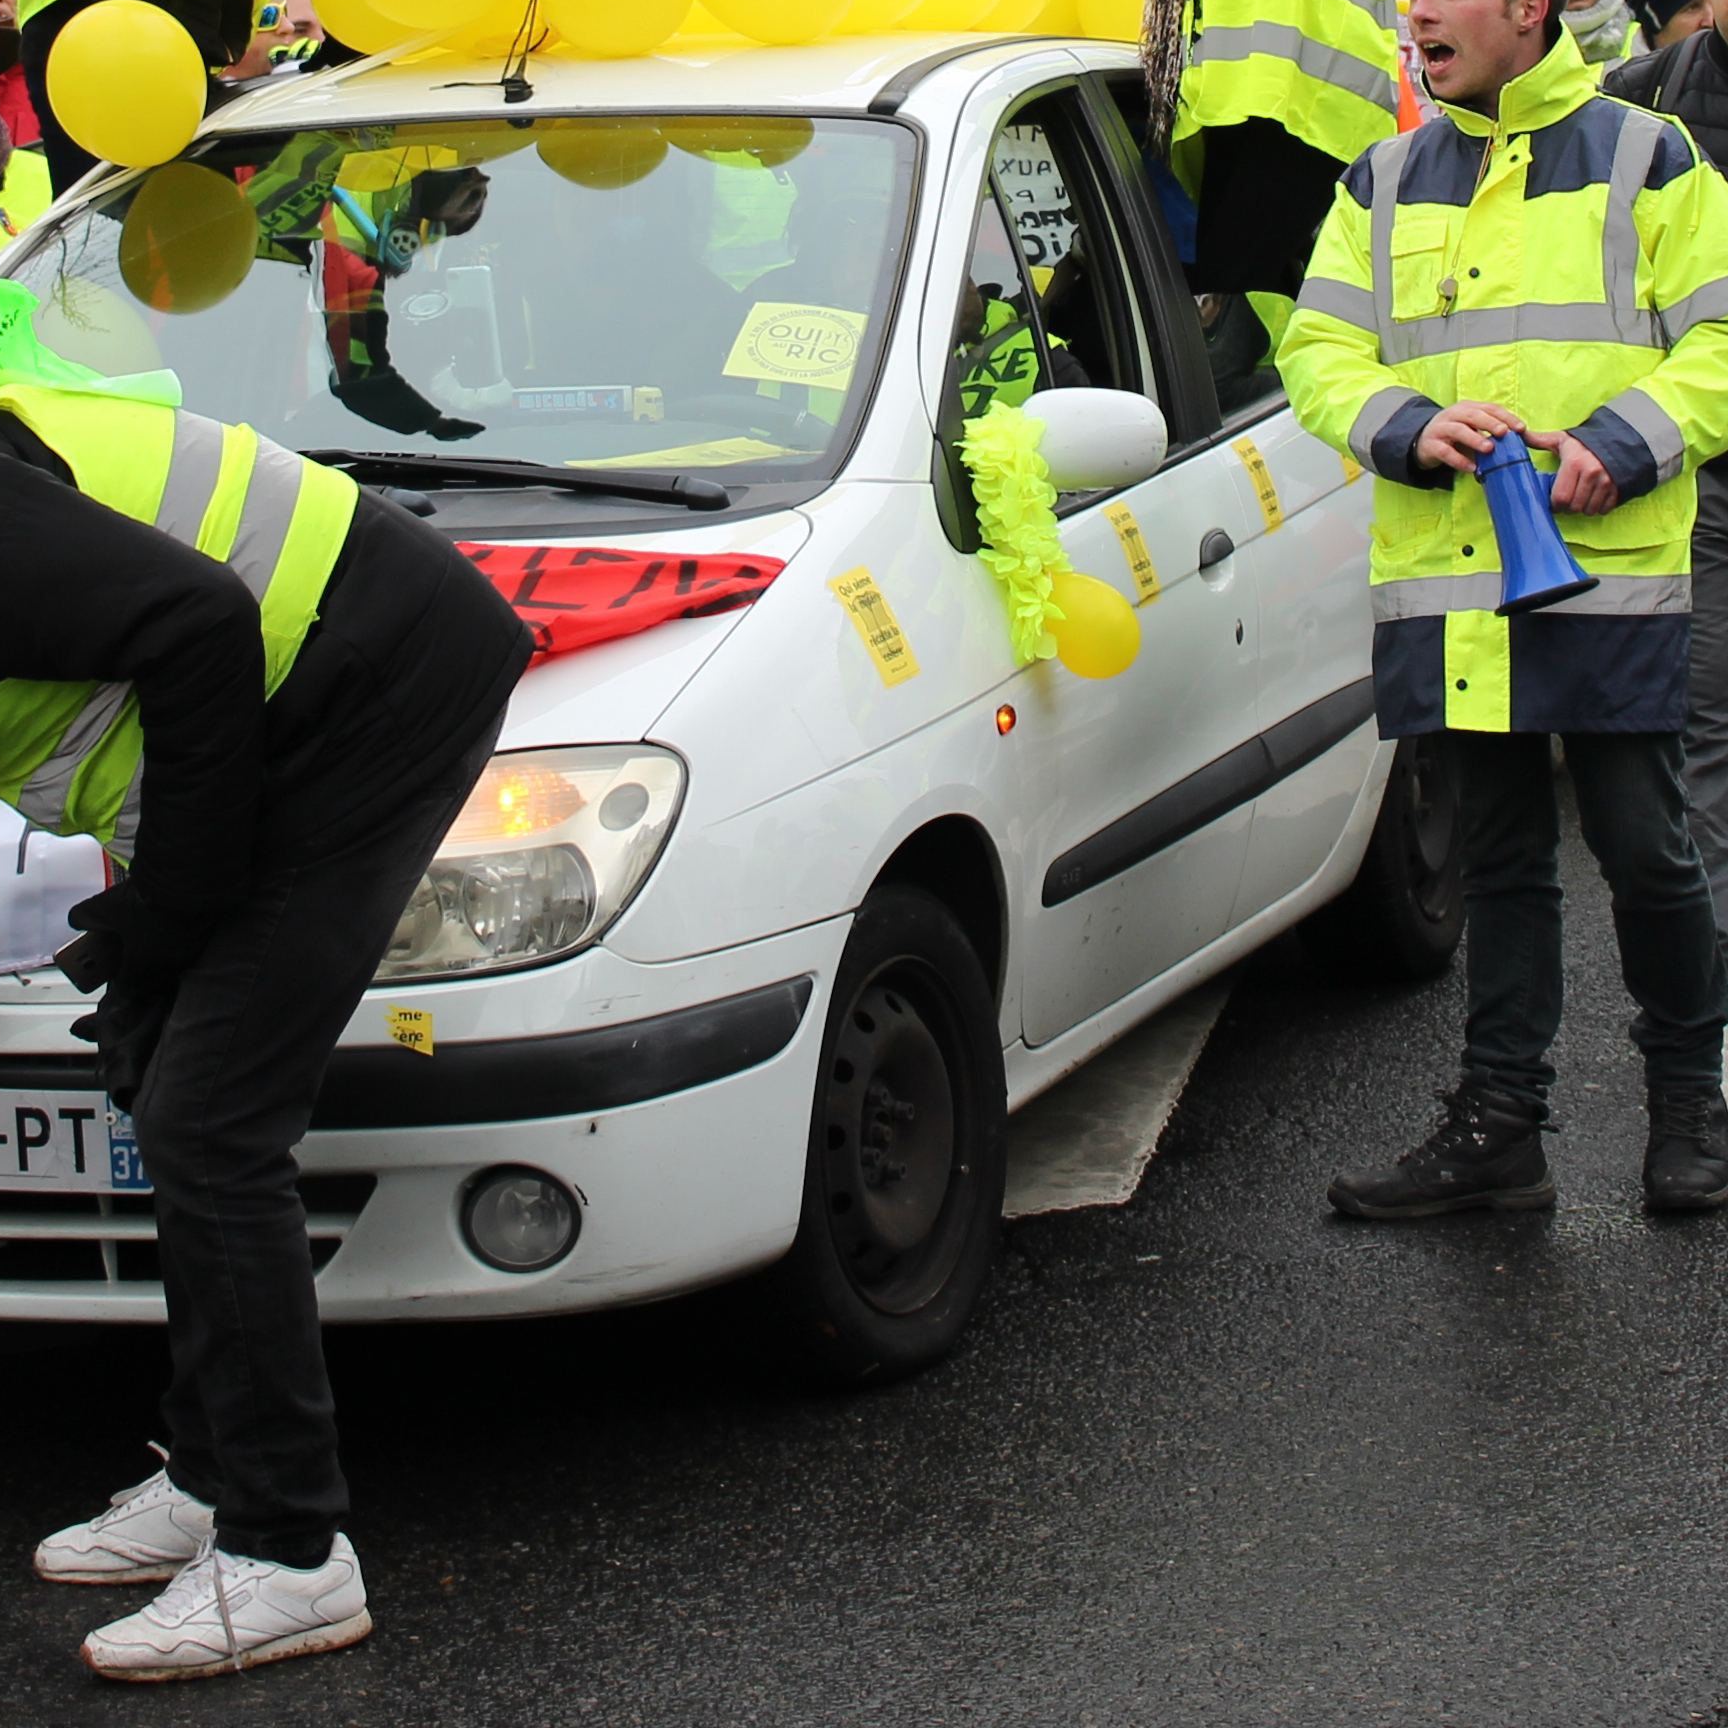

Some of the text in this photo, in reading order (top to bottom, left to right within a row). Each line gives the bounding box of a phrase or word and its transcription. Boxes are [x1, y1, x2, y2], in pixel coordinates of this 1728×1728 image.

[768, 324, 824, 344] OUI
[398, 1011, 423, 1022] me
[398, 1028, 424, 1043] ère
